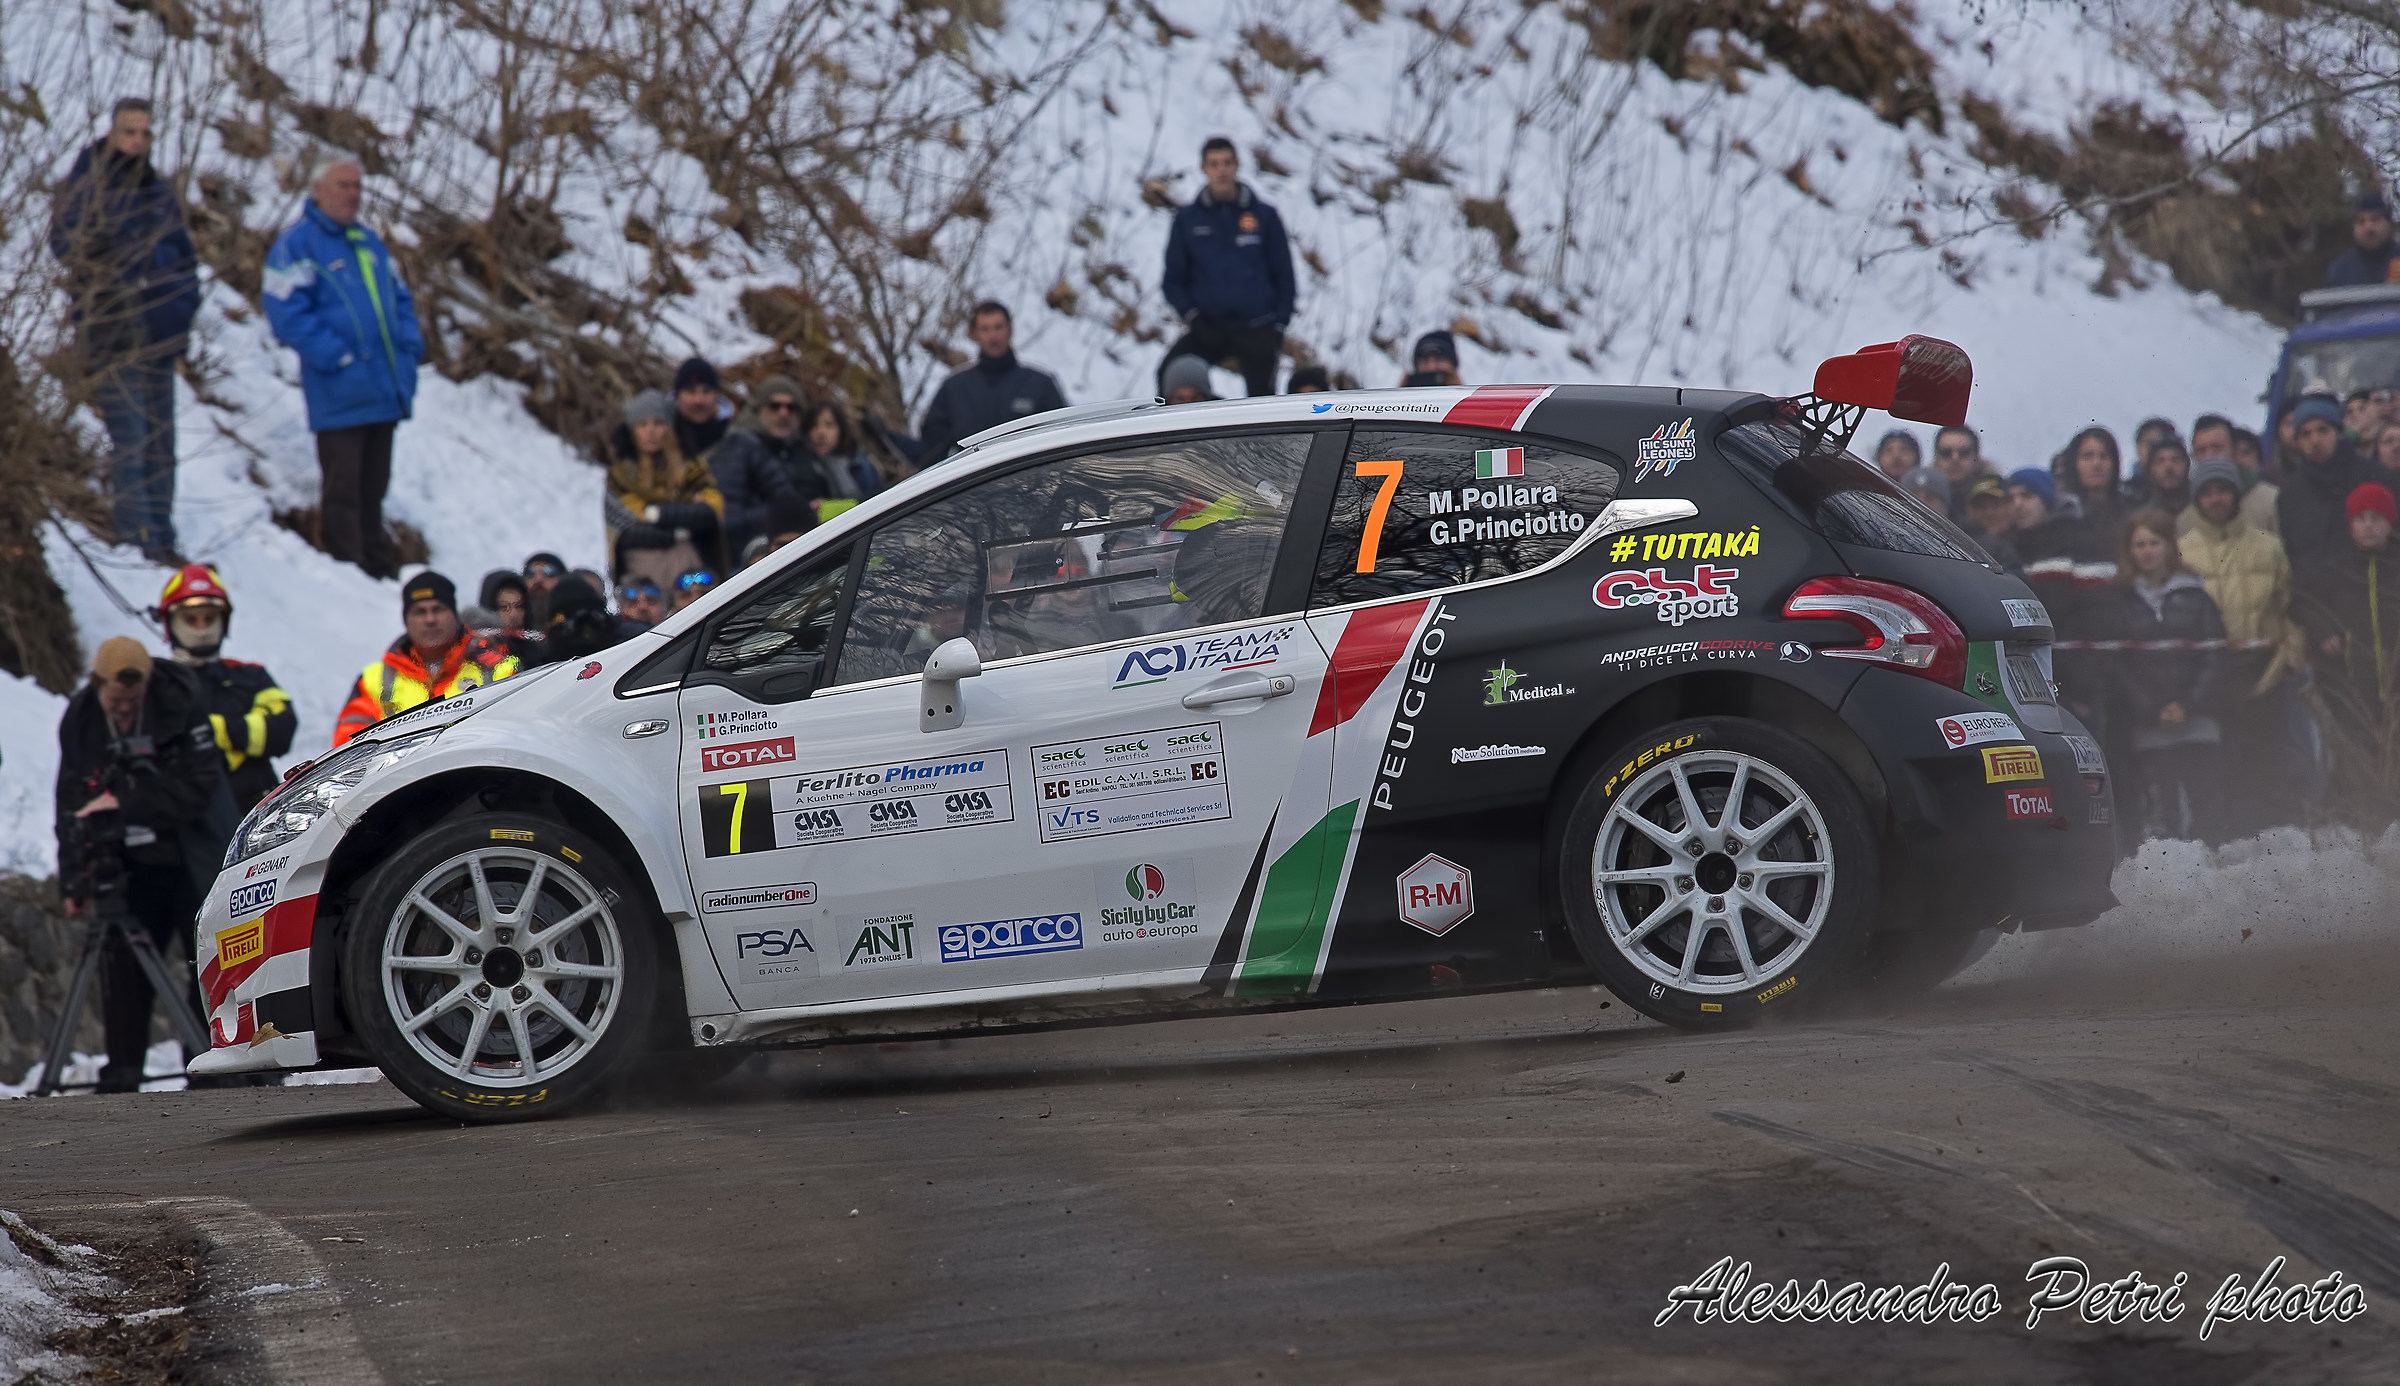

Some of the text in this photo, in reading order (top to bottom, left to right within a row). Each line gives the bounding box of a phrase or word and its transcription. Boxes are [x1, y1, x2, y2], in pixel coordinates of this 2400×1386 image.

[1335, 403, 1440, 414] @peugeotitalia
[1642, 440, 1692, 450] HIC SUNT
[1643, 448, 1693, 460] LEONES
[1429, 484, 1558, 514] M.Pollara
[1355, 460, 1404, 573] 7
[1430, 510, 1585, 546] G.Princiotto
[1661, 595, 1736, 623] sport
[1195, 630, 1273, 655] TEAM
[1116, 645, 1187, 682] ACI
[1188, 644, 1280, 671] ITALIA
[1618, 650, 1757, 672] TI DICE LA CURVA
[1509, 684, 1564, 702] Medical
[718, 711, 768, 723] M.Pollara
[1373, 604, 1457, 811] PEUGEOT
[719, 721, 778, 736] G.Princiotto
[1963, 718, 1992, 731] EURO
[704, 745, 793, 767] TOTAL
[1105, 752, 1150, 763] scientifica
[1168, 744, 1213, 755] scientifica
[1453, 749, 1478, 763] New
[1480, 745, 1520, 758] Solution
[1042, 760, 1087, 771] scientifica
[1190, 761, 1218, 780] EC
[1989, 751, 2040, 777] PIRELLI
[796, 760, 985, 794] Ferlito Pharma
[1075, 778, 1101, 788] EDIL
[1153, 767, 1186, 778] S.R.L.
[796, 797, 805, 805] A
[807, 791, 844, 804] Kuehne
[858, 787, 888, 798] Nagel
[890, 782, 938, 794] Company
[1043, 780, 1071, 800] EC
[1108, 814, 1140, 824] Validation
[1141, 811, 1154, 819] and
[1155, 806, 1186, 817] Technical
[1187, 804, 1213, 813] Services
[2008, 794, 2053, 815] TOTAL
[720, 782, 748, 854] 7
[1053, 806, 1100, 827] VTS
[257, 856, 290, 875] GENART
[231, 881, 276, 915] sparco
[1409, 882, 1462, 909] R-M
[863, 914, 914, 925] FONDAZIONE
[1101, 902, 1196, 926] Sicily by Car
[220, 926, 260, 962] PIRELLI
[737, 928, 815, 959] PSA
[844, 922, 915, 967] ANT
[942, 915, 1080, 958] sparco
[1103, 928, 1134, 942] auto
[859, 953, 902, 965] 1978 ONLUS
[759, 966, 800, 976] BANCA
